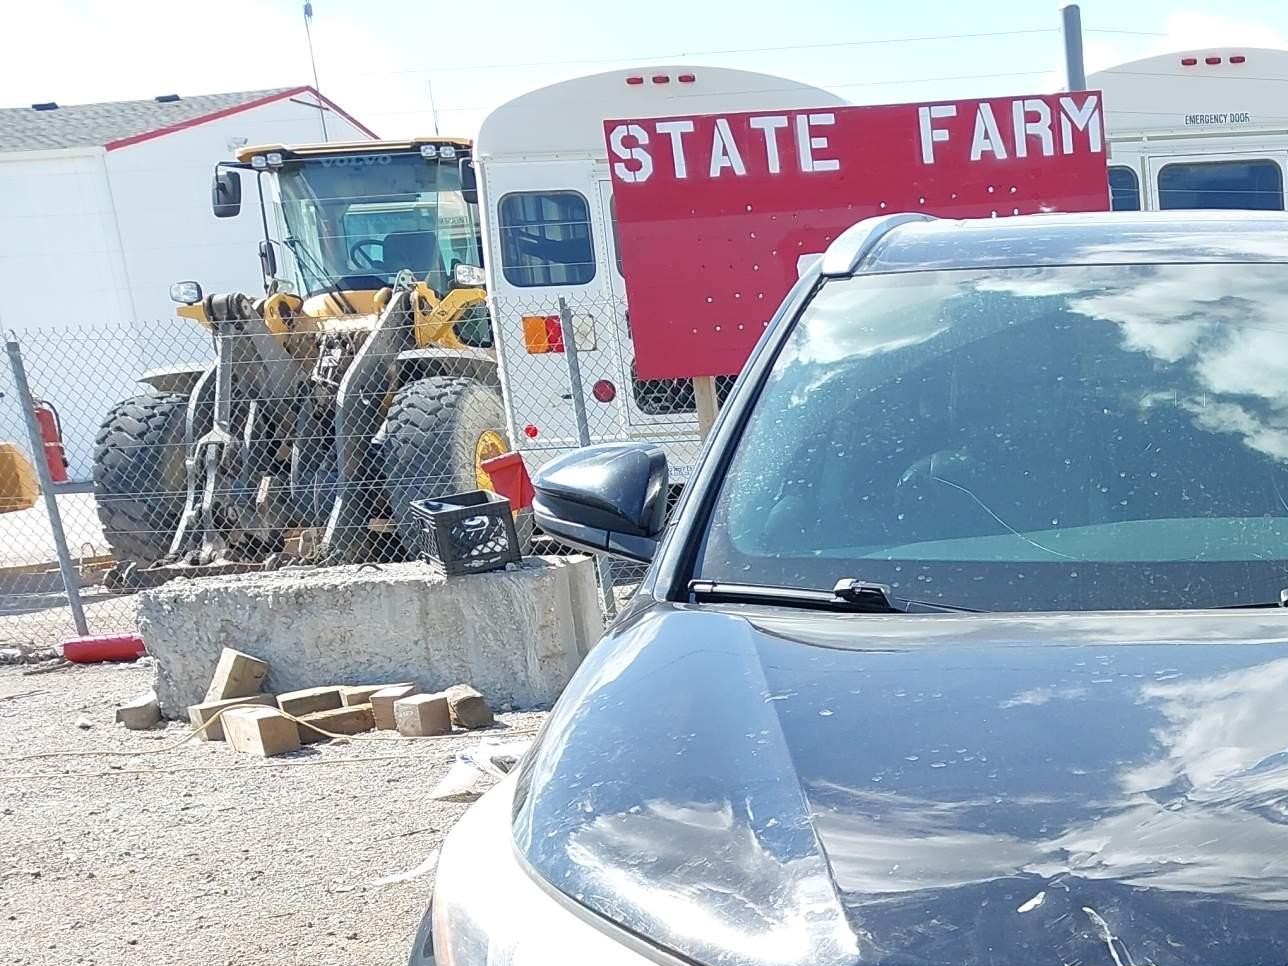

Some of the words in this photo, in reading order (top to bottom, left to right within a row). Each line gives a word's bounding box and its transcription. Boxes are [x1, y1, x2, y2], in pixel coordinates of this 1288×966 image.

[1184, 113, 1228, 125] EMERGENCY
[1229, 112, 1250, 123] DOOR
[608, 112, 841, 183] STATE
[918, 95, 1102, 164] FARM
[319, 154, 392, 168] VOLVO
